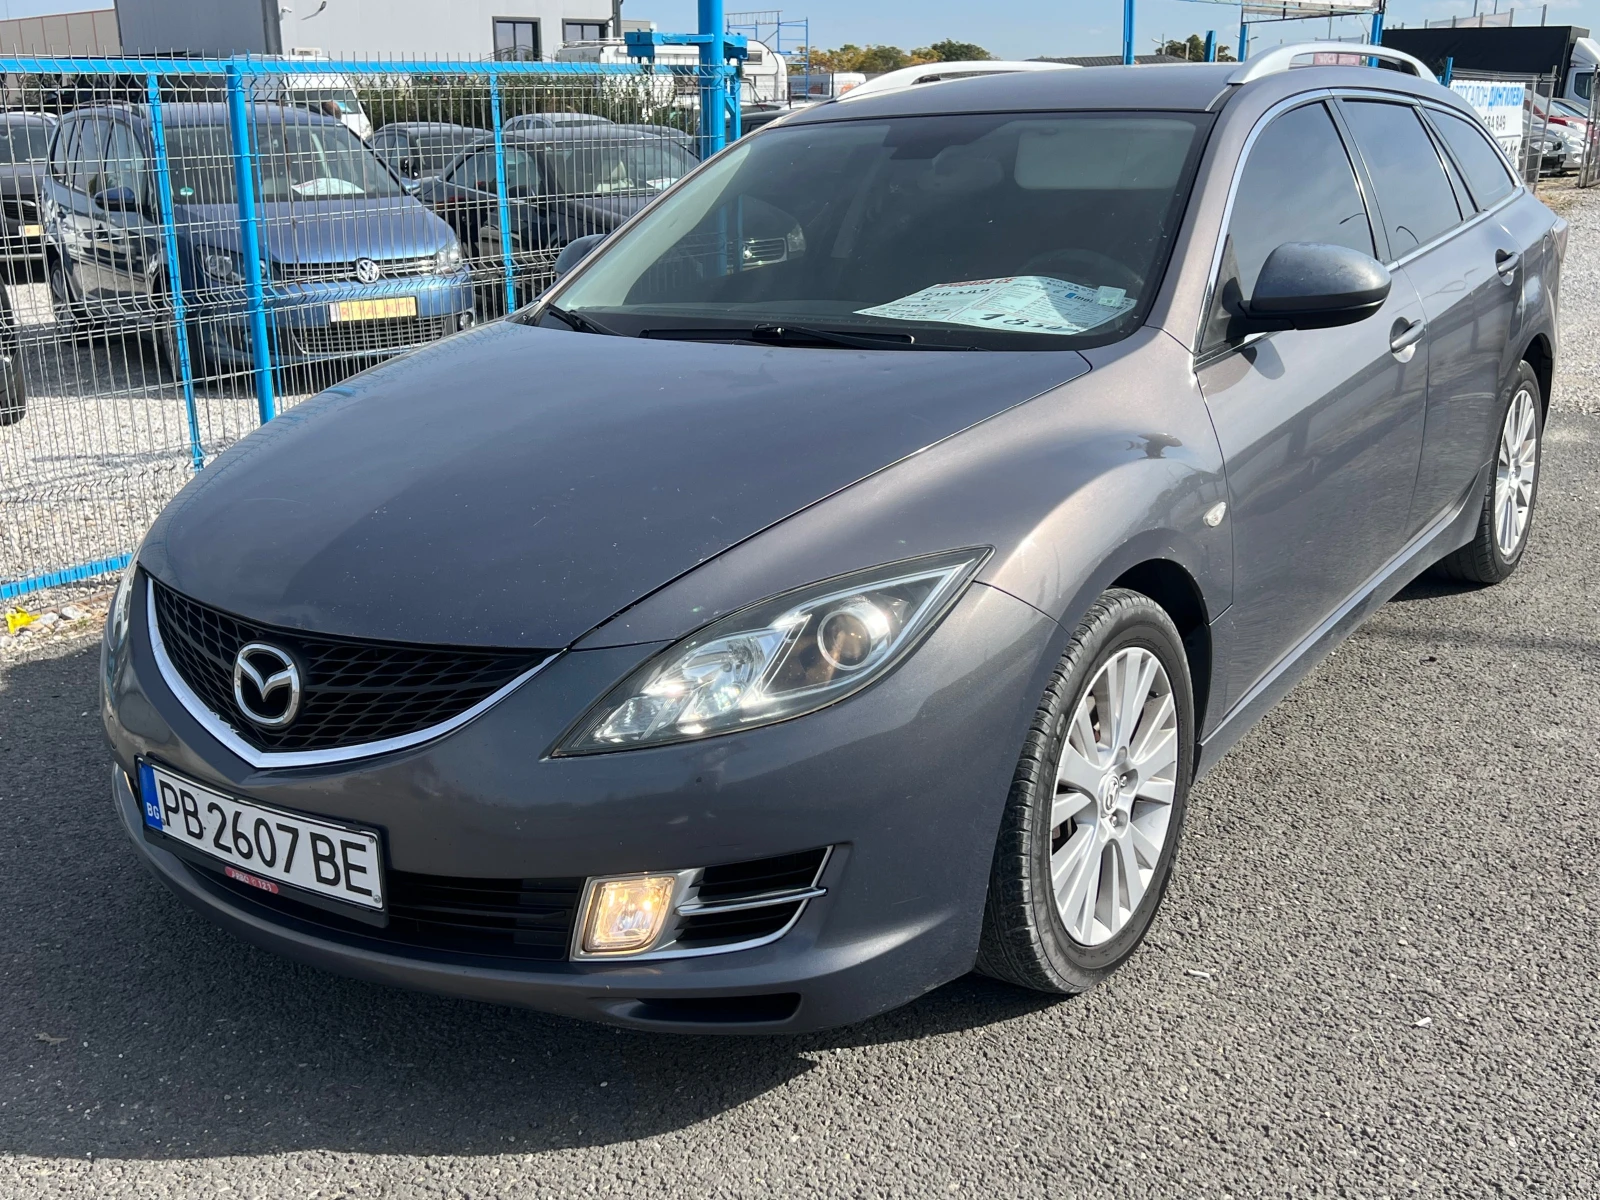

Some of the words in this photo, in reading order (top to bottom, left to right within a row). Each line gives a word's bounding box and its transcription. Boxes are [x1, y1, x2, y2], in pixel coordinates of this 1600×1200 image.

[146, 801, 160, 820] BG
[159, 779, 204, 840] PB
[207, 802, 299, 874] 2607
[309, 832, 373, 897] BE
